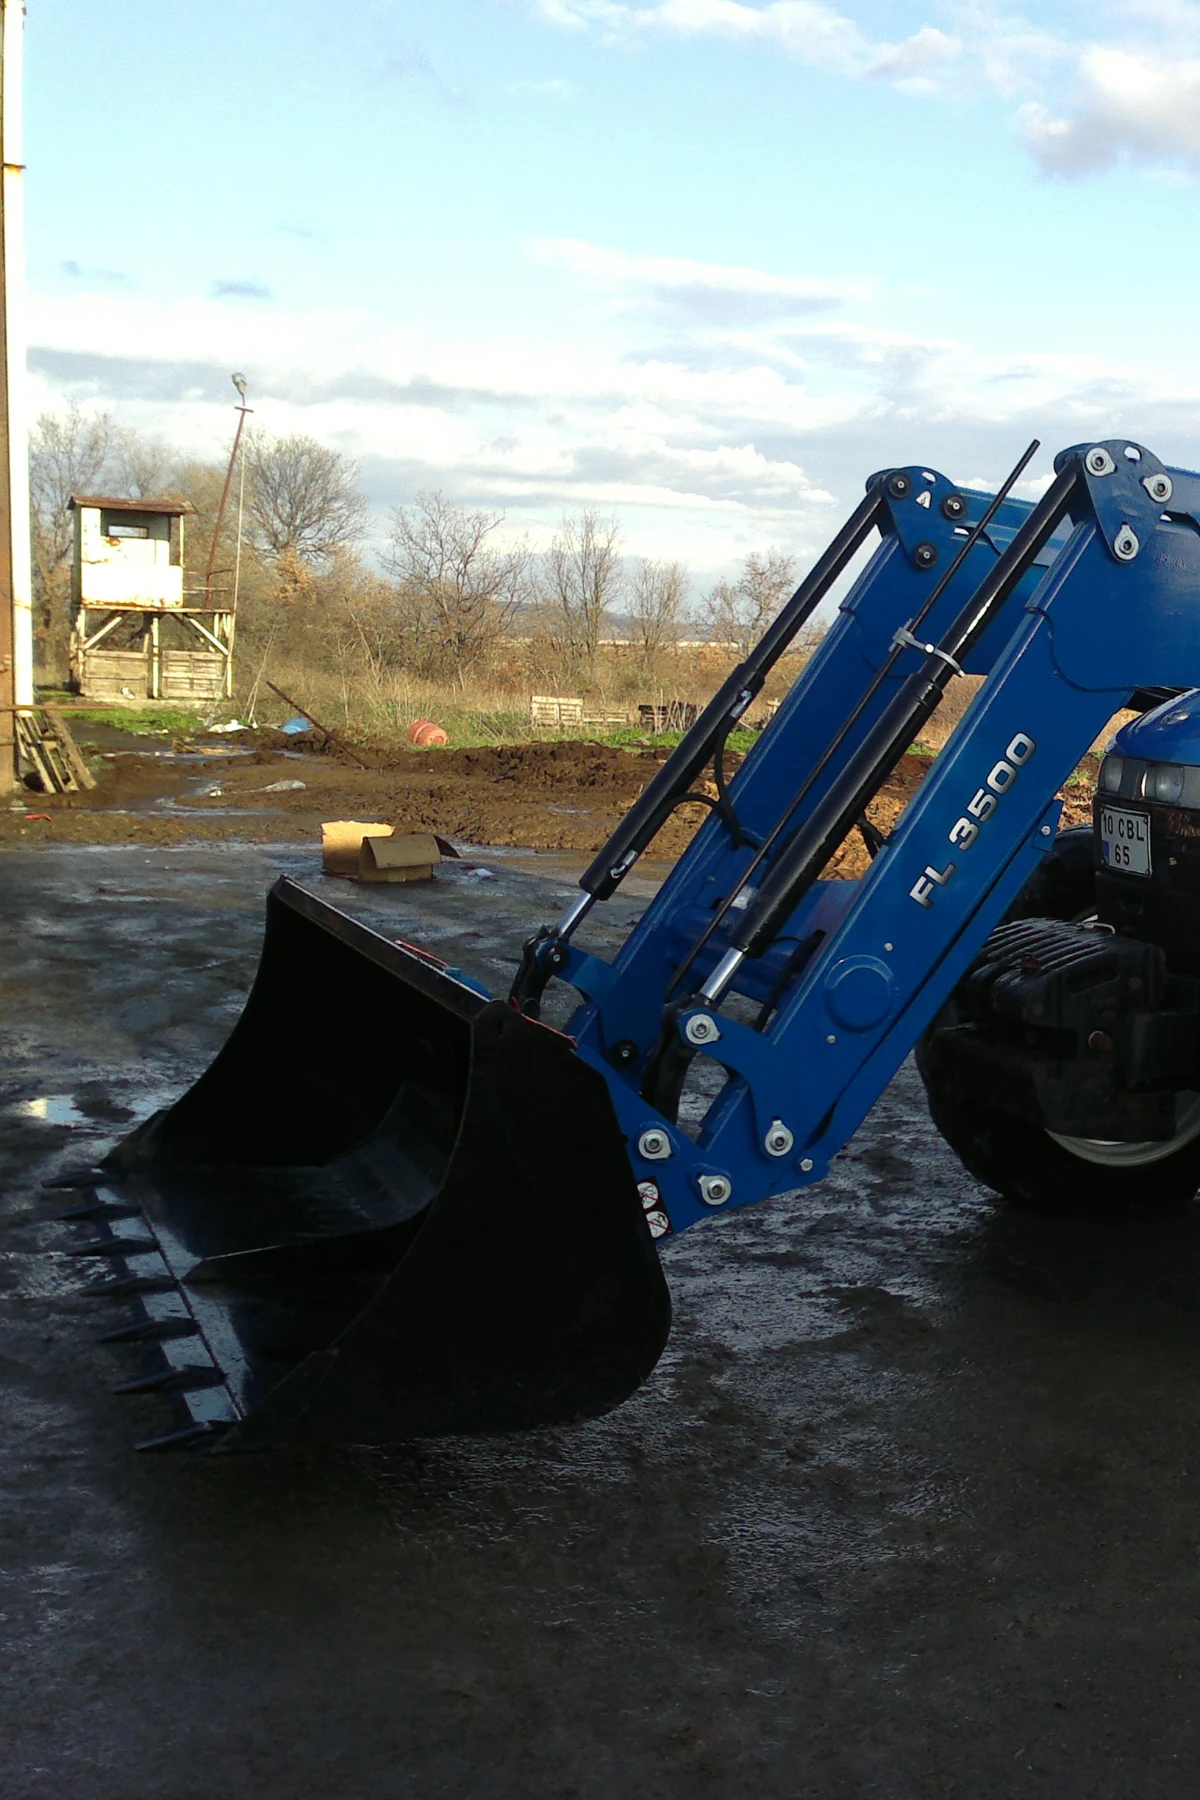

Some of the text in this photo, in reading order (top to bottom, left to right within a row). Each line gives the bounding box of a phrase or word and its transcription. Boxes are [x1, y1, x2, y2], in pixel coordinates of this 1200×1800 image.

[908, 731, 1037, 910] FL 3500
[1103, 814, 1145, 841] 10 CBL
[1114, 843, 1130, 866] 65
